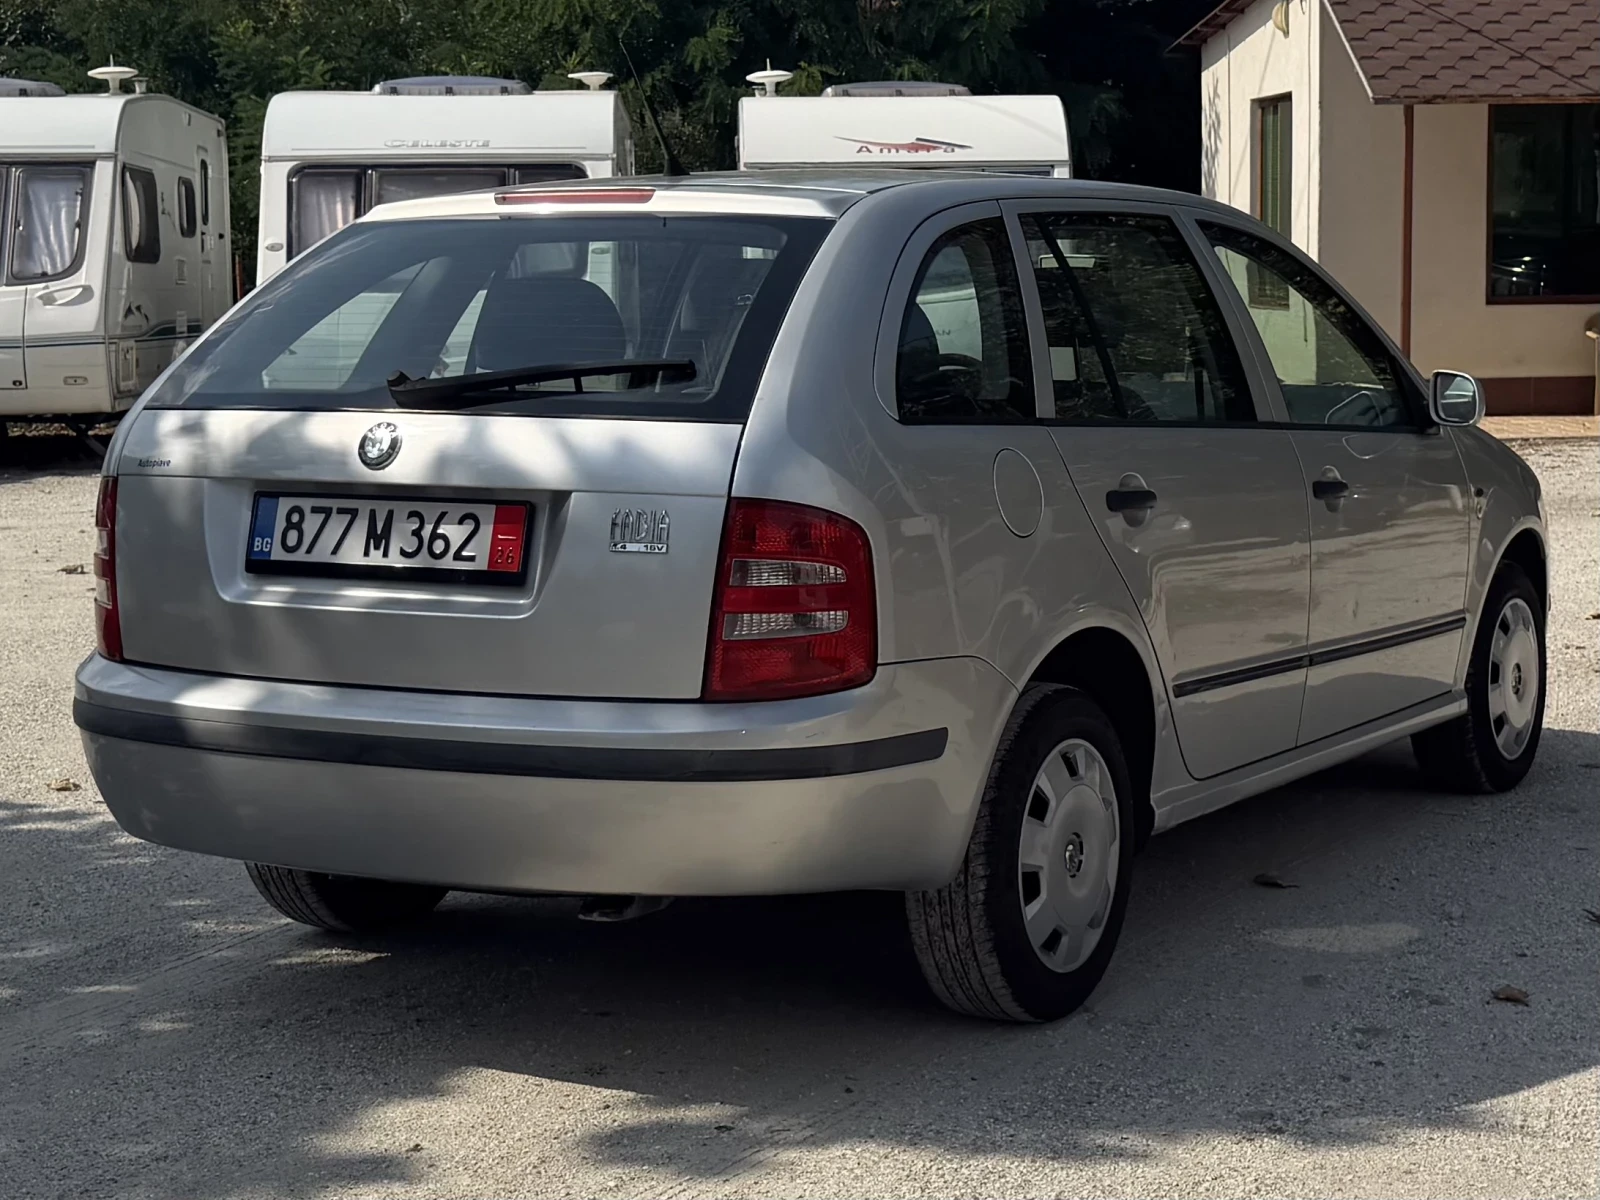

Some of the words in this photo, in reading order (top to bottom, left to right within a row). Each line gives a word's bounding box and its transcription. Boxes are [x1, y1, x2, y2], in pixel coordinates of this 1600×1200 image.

[384, 139, 490, 148] CELESTE
[856, 145, 956, 154] Amara
[280, 504, 359, 556] 877
[363, 508, 395, 559] M
[400, 510, 481, 563] 362
[609, 508, 670, 544] FABIA
[253, 537, 272, 552] BG
[643, 544, 665, 552] 16V
[494, 546, 514, 565] 26
